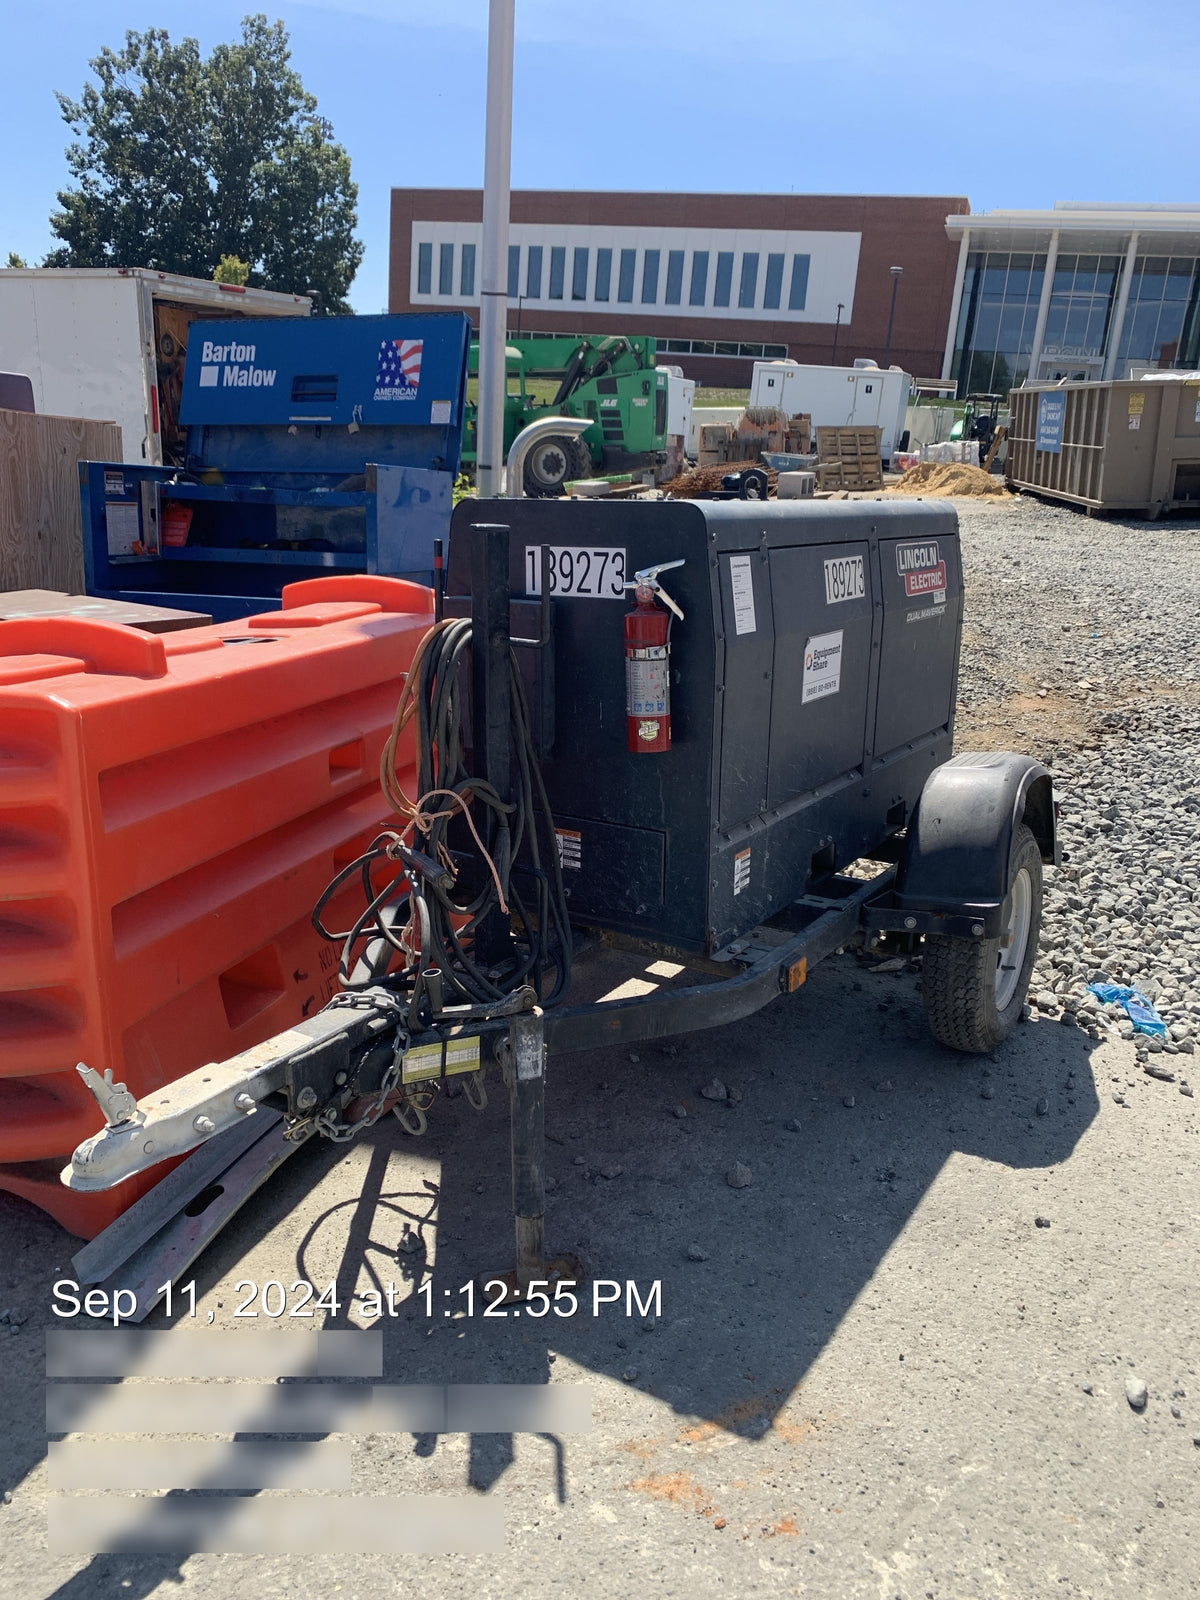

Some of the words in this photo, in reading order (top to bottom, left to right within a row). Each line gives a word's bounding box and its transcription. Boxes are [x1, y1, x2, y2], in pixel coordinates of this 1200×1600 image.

[201, 341, 256, 363] Barton
[222, 365, 277, 387] Malow
[374, 387, 418, 396] AMERICAN
[600, 398, 618, 407] JLG
[898, 546, 938, 570] LINCOLN
[825, 558, 865, 601] 189273
[909, 571, 943, 591] ELECTRIC
[813, 644, 841, 661] Equipment
[812, 660, 828, 672] Share
